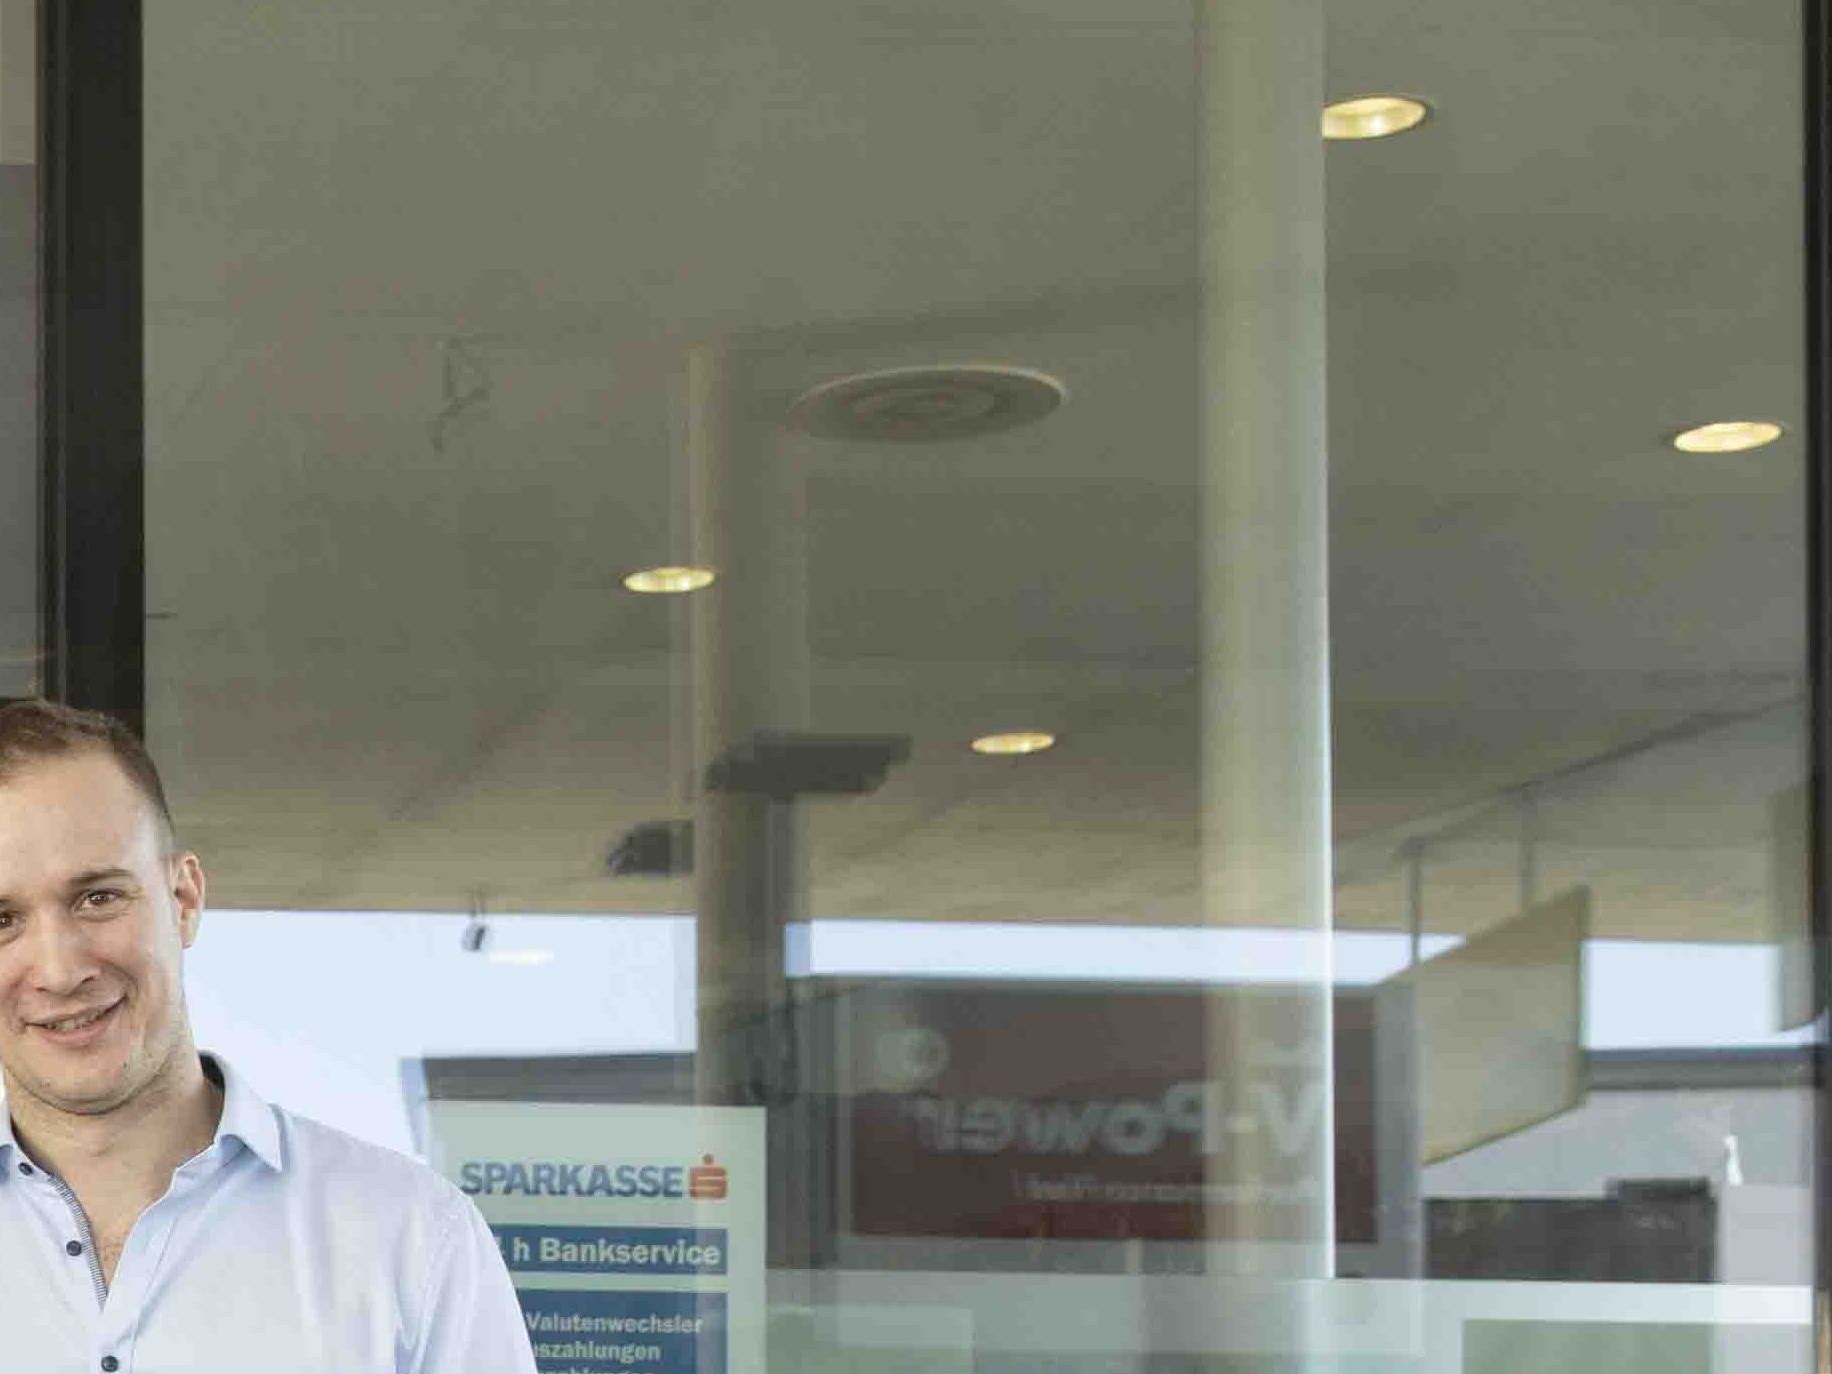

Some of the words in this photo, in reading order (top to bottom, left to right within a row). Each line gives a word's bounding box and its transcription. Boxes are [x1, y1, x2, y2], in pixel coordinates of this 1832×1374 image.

[460, 1161, 685, 1199] SPARKASSE
[513, 1236, 531, 1262] h
[539, 1236, 721, 1266] Bankservice
[526, 1310, 705, 1334] Valutenwechsler
